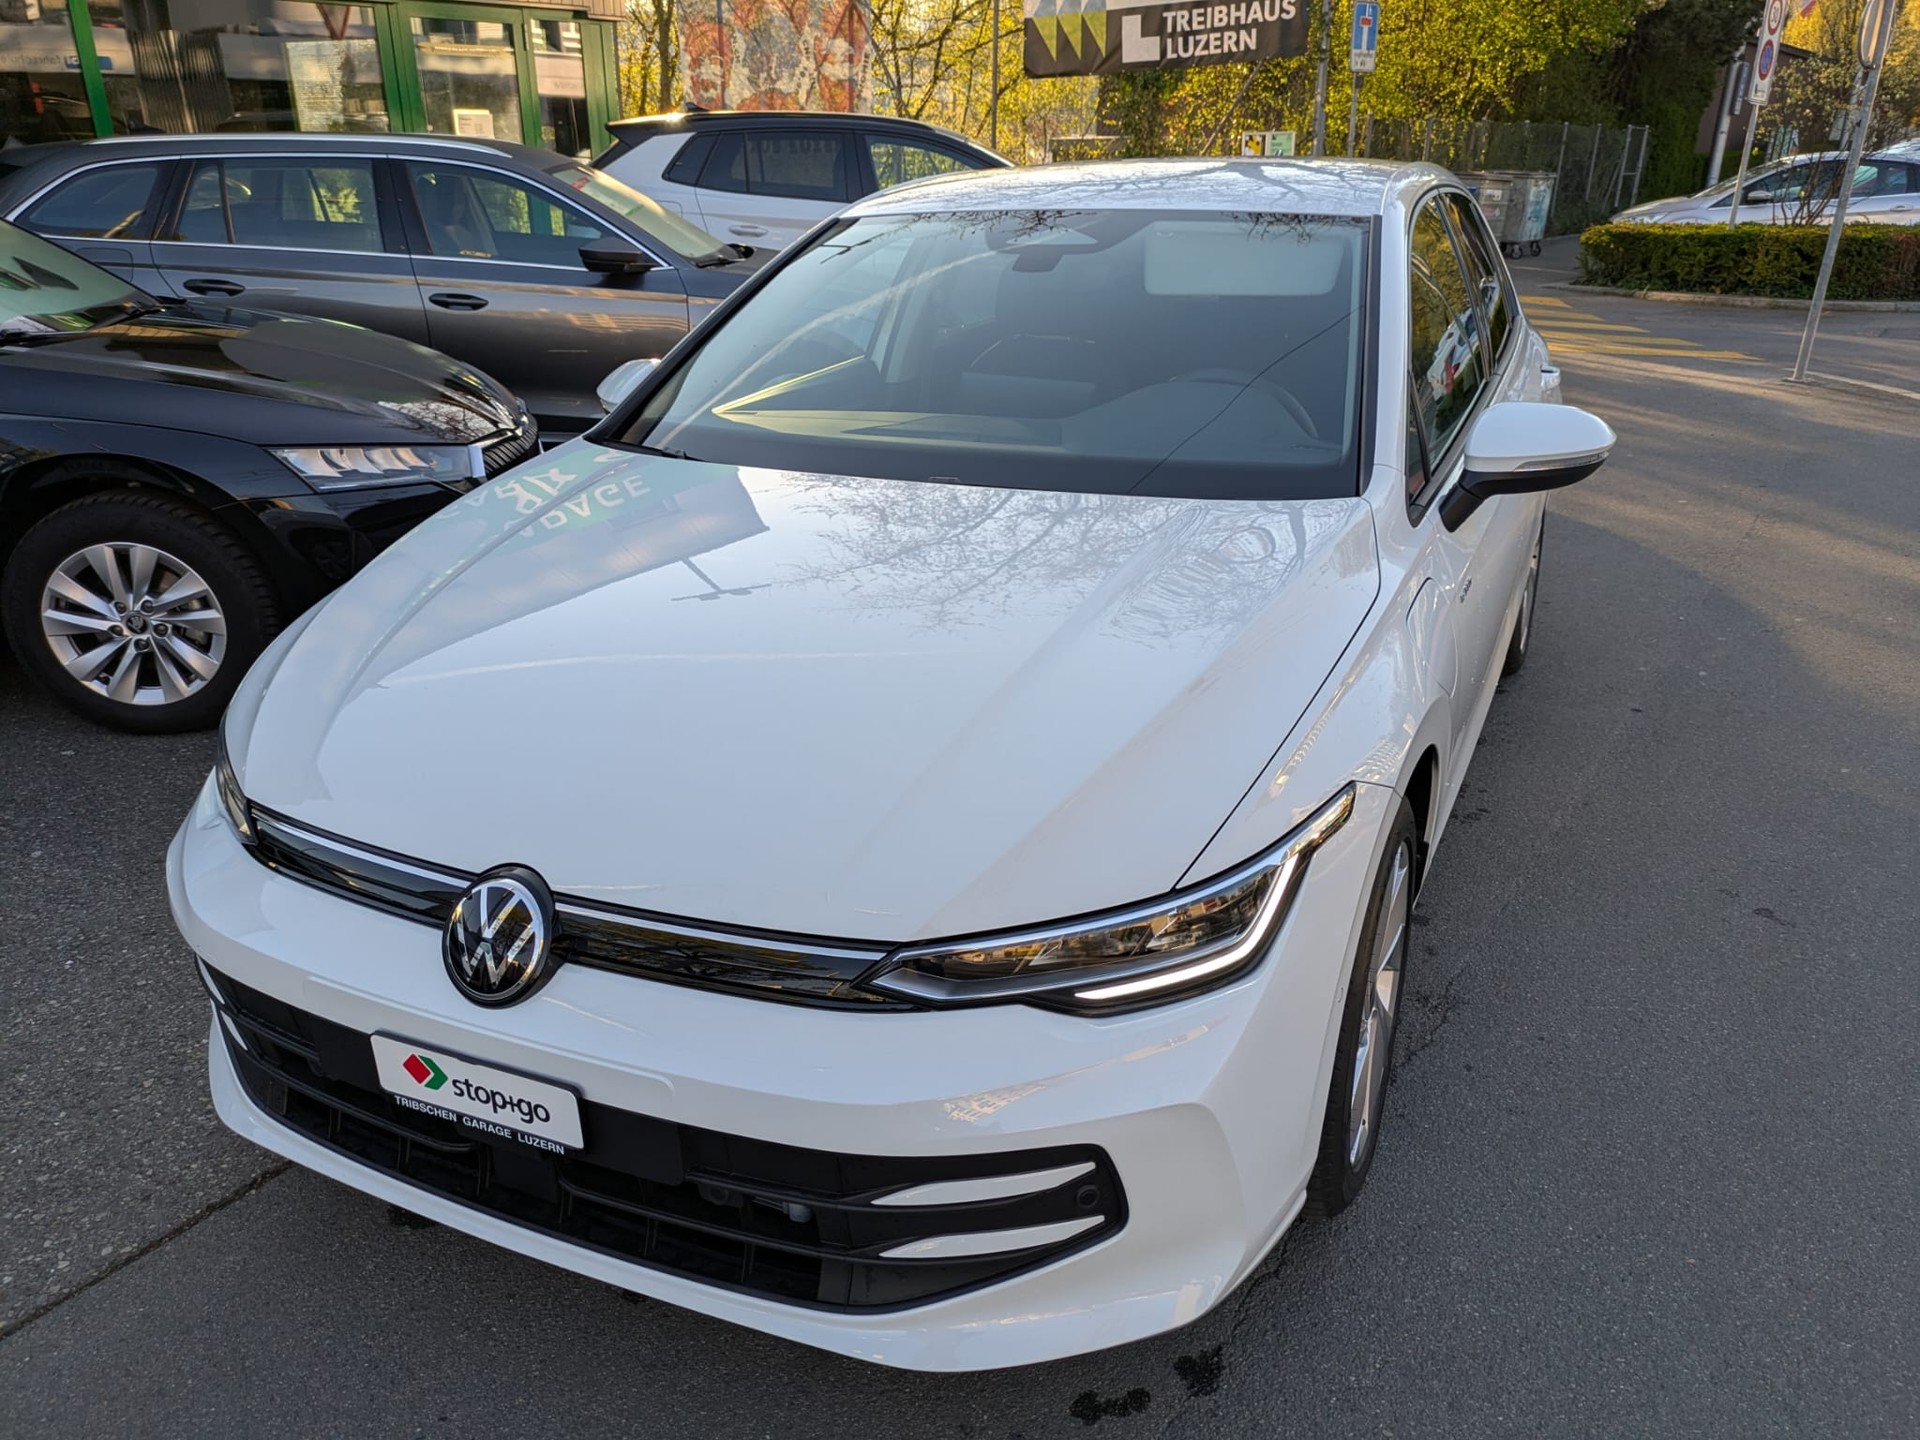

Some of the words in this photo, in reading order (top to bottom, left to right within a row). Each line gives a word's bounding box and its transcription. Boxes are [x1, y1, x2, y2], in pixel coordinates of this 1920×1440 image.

[1163, 0, 1296, 33] TREIBHAUS
[1166, 28, 1258, 59] LUZERN
[451, 1077, 551, 1124] stop+go
[394, 1095, 457, 1122] TRIBSCHEN
[462, 1116, 512, 1139] GARAGE
[517, 1133, 565, 1155] LUZERN
